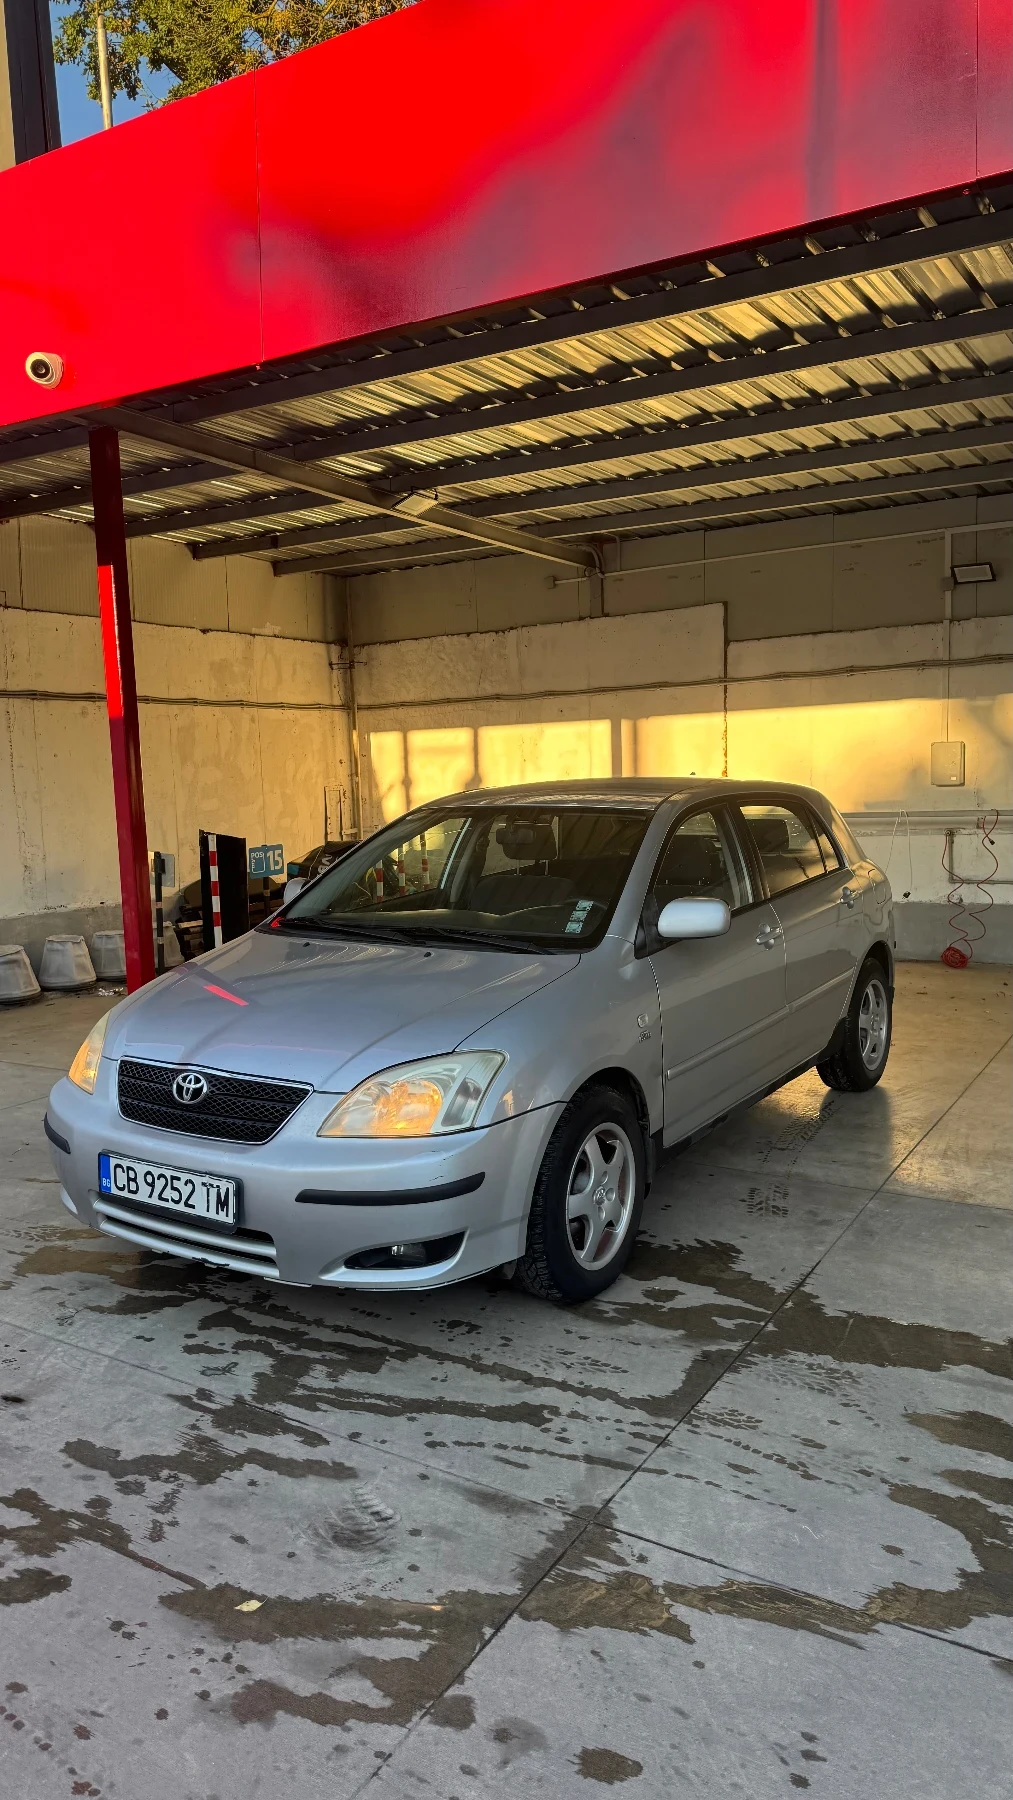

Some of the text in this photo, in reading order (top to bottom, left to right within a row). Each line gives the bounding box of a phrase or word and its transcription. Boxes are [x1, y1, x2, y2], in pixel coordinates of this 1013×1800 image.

[267, 849, 282, 870] 15
[102, 1178, 111, 1188] BG
[113, 1163, 229, 1217] CB 9252 TM
